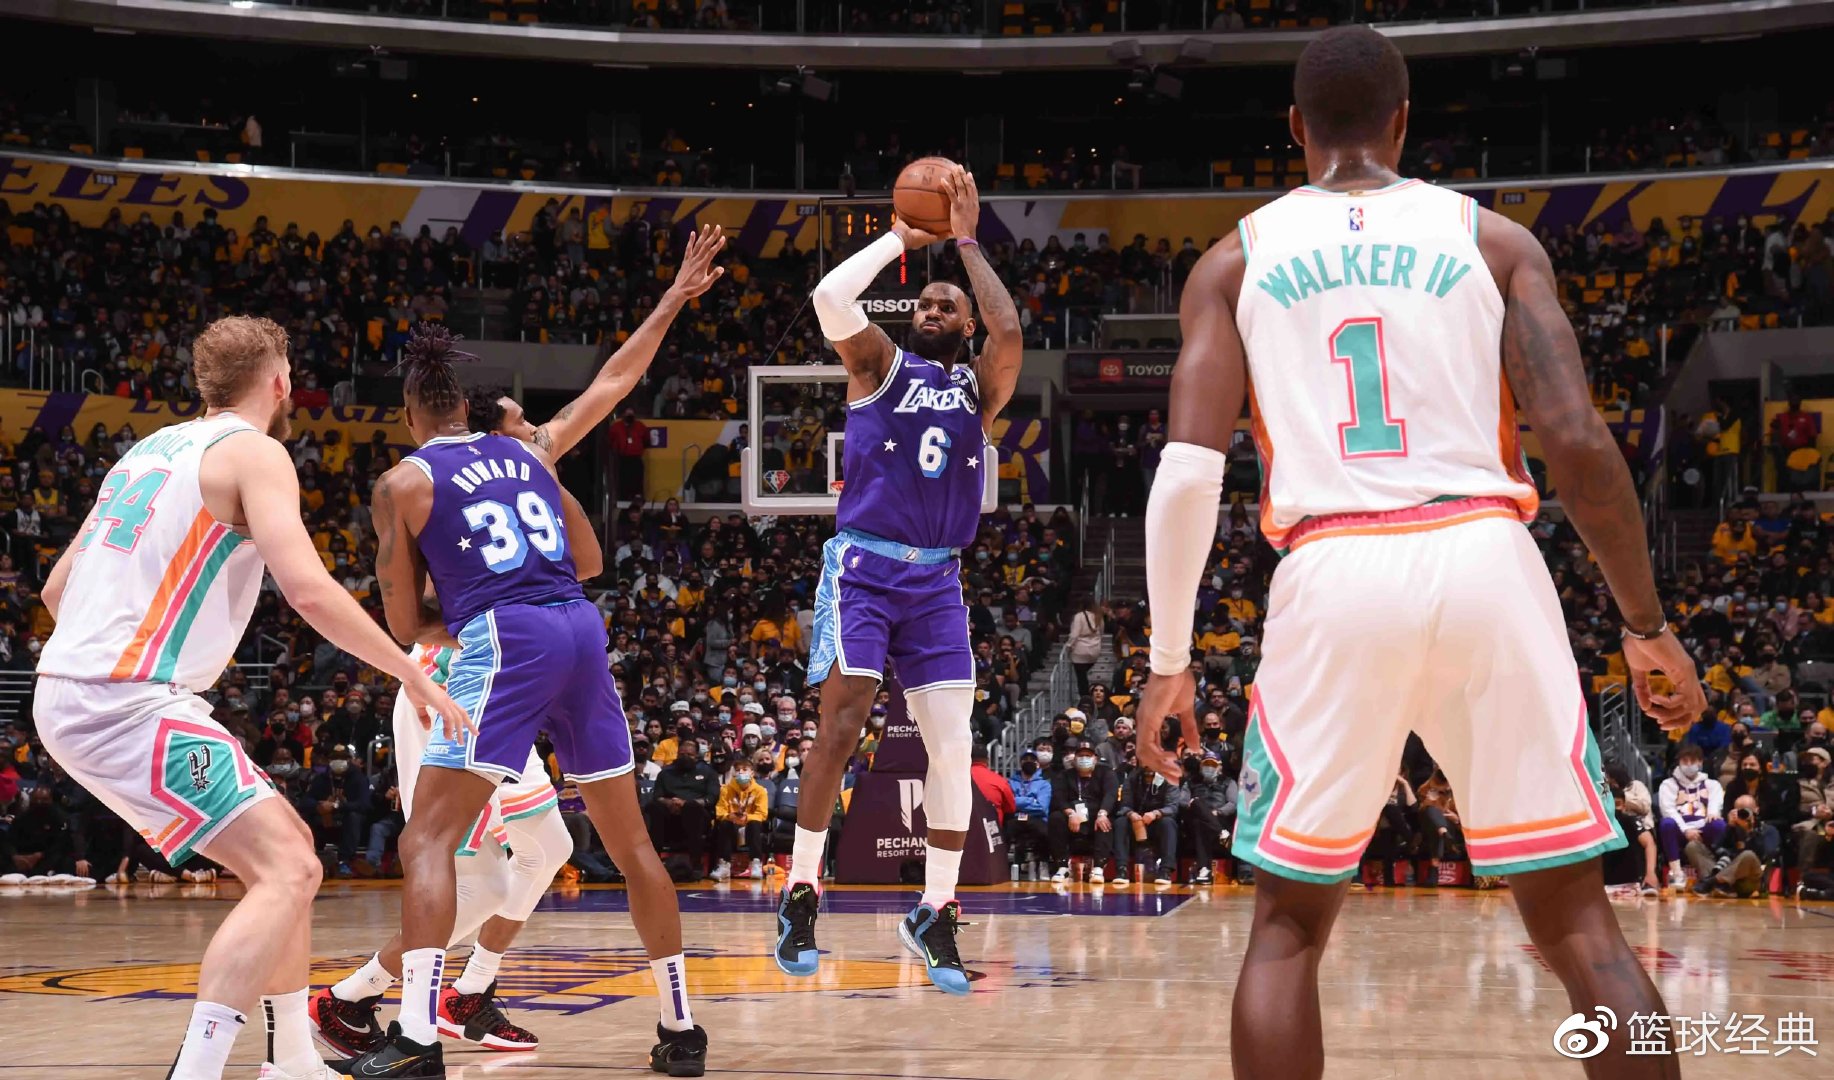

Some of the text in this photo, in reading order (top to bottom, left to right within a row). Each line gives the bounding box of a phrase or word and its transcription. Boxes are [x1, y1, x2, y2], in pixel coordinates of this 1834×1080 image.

[1257, 244, 1471, 309] WALKER IV
[1328, 317, 1408, 460] 1
[918, 425, 952, 478] 6
[451, 459, 530, 494] HOWARD
[461, 491, 564, 574] 39
[887, 725, 920, 733] PECHA
[876, 837, 927, 849] PECHAN
[876, 849, 909, 858] RESORT
